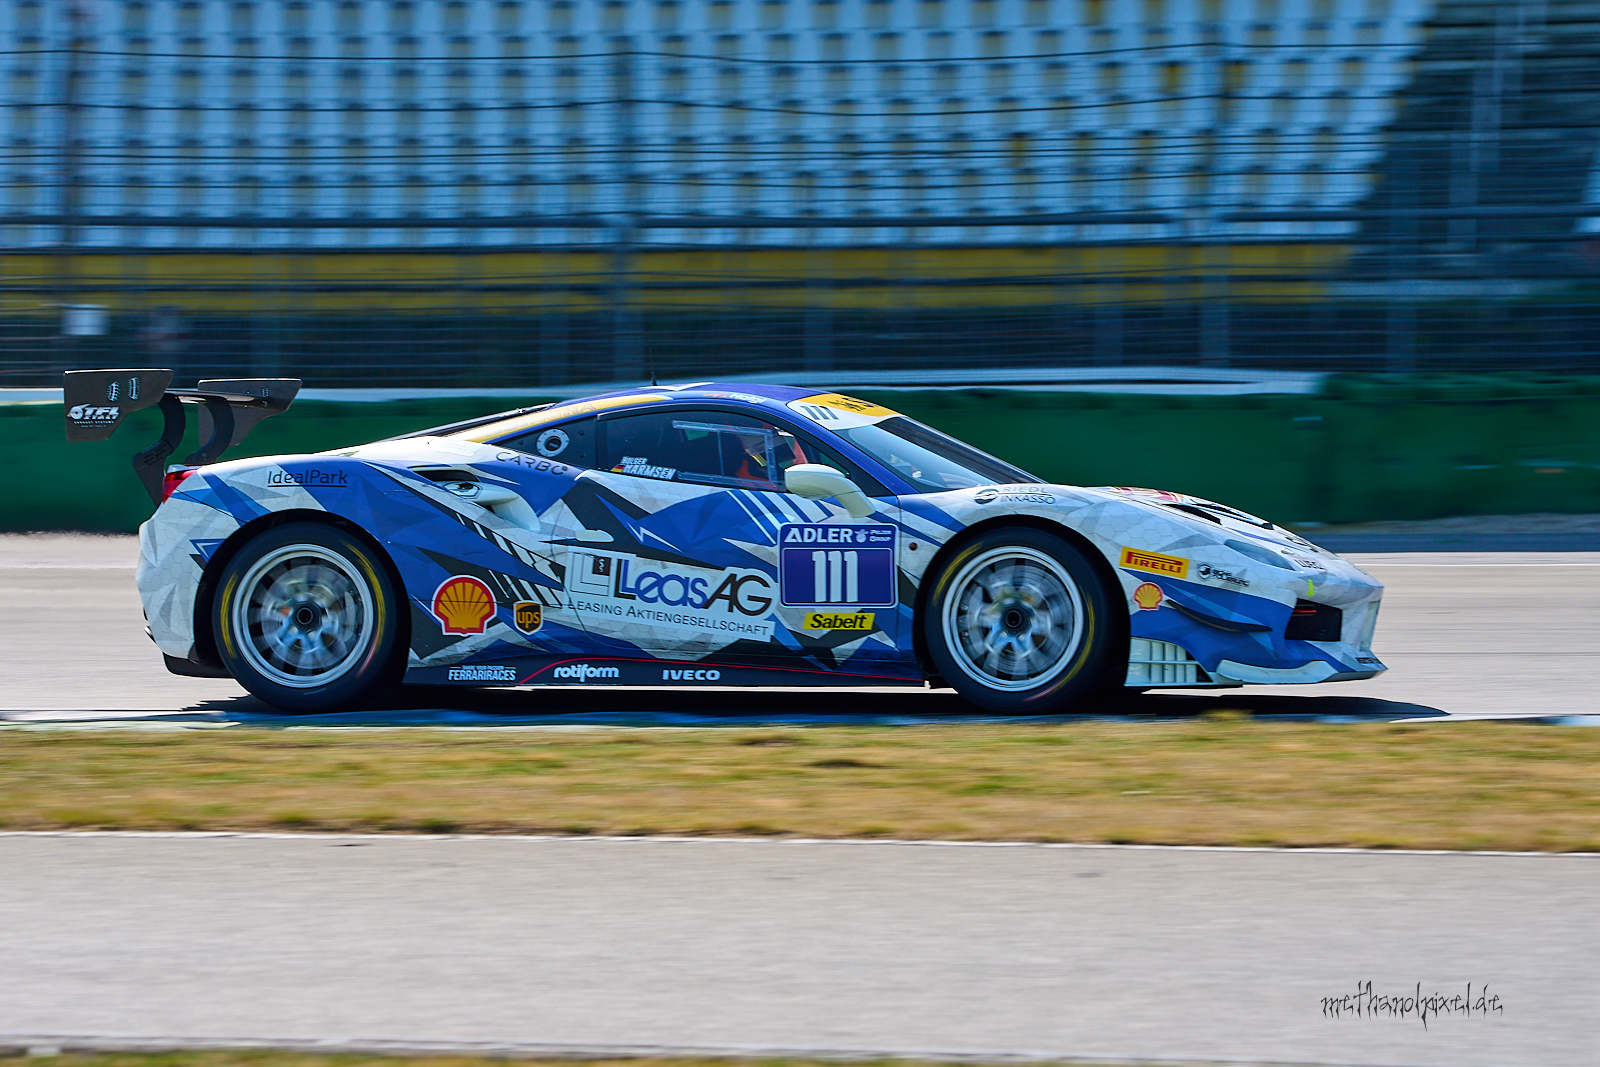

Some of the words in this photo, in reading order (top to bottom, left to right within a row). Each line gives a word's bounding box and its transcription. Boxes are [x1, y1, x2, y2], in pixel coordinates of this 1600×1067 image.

[84, 407, 119, 415] TFL
[800, 405, 839, 420] 111
[268, 469, 348, 484] IdealPark
[623, 464, 677, 480] HARMSEN
[1000, 494, 1056, 505] INKASSO
[784, 527, 853, 543] ADLER
[1126, 551, 1183, 574] PIRELLI
[812, 550, 858, 603] 111
[614, 558, 773, 616] LeasAG
[517, 611, 540, 629] ups
[568, 597, 623, 616] LEASING
[626, 605, 769, 636] AKTIENGESELLSCHAFT
[810, 614, 867, 629] Sabelt
[448, 670, 516, 681] FERRARIRACES
[553, 663, 620, 682] rotiform
[662, 669, 721, 681] IVECO
